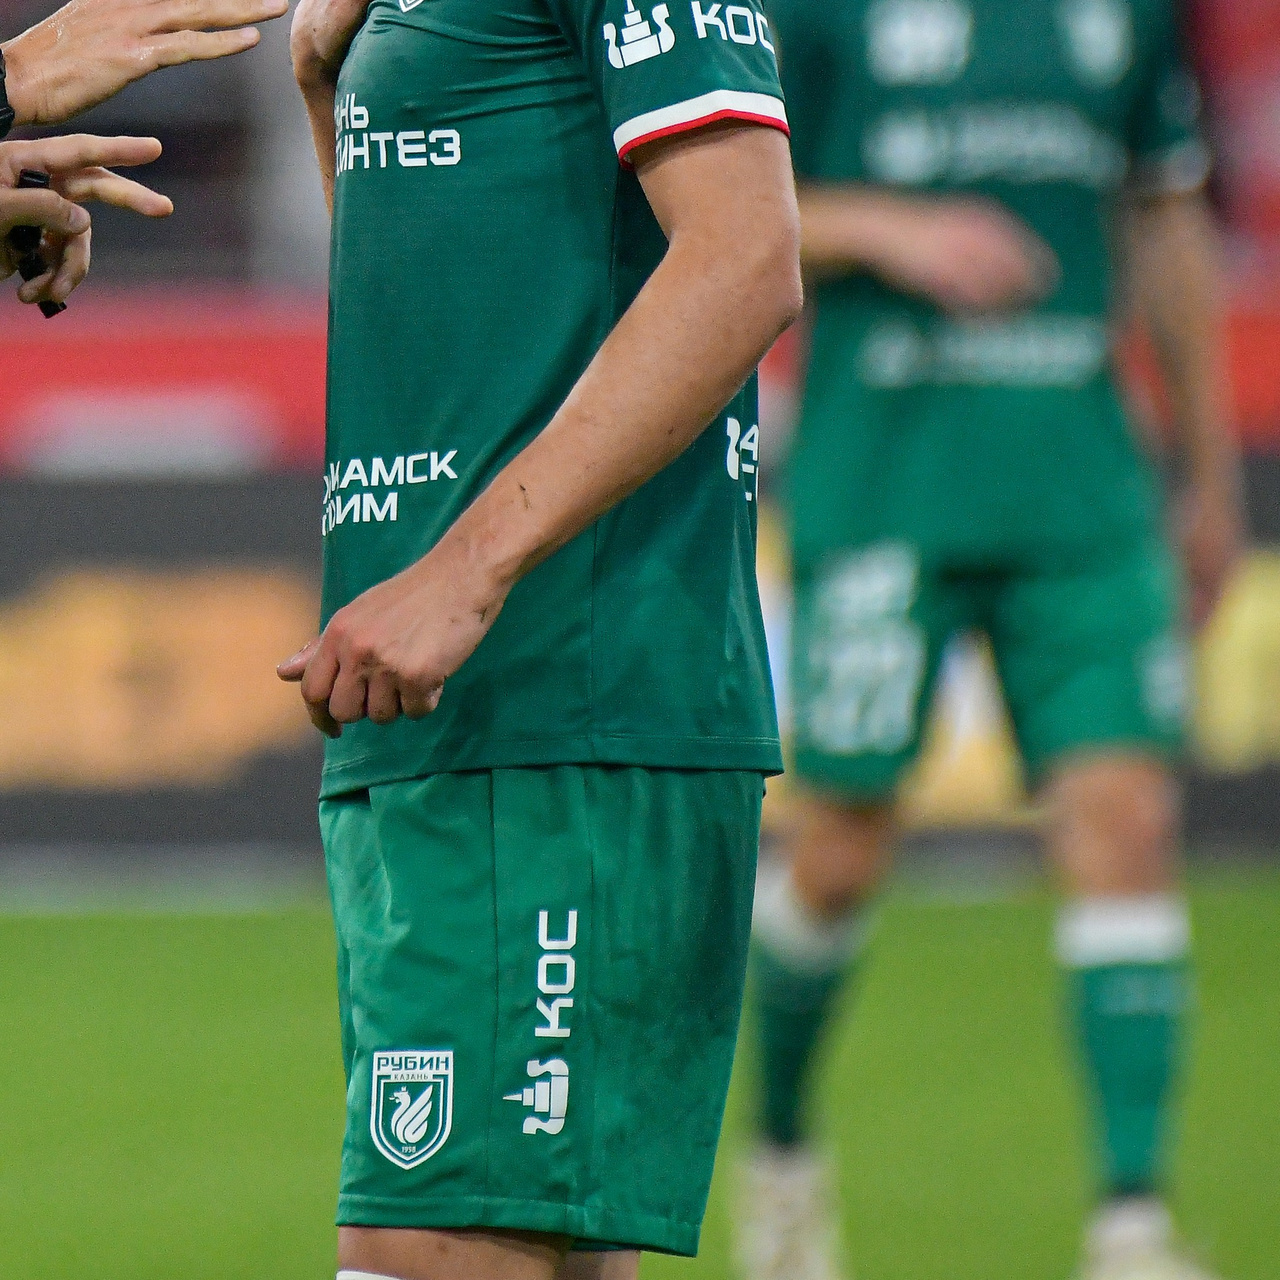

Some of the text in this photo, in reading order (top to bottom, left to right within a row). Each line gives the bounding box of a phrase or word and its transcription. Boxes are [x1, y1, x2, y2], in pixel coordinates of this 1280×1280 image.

[534, 910, 578, 1038] КОС
[376, 1056, 450, 1072] РУБИН
[393, 1073, 429, 1081] КАЗАНЬ
